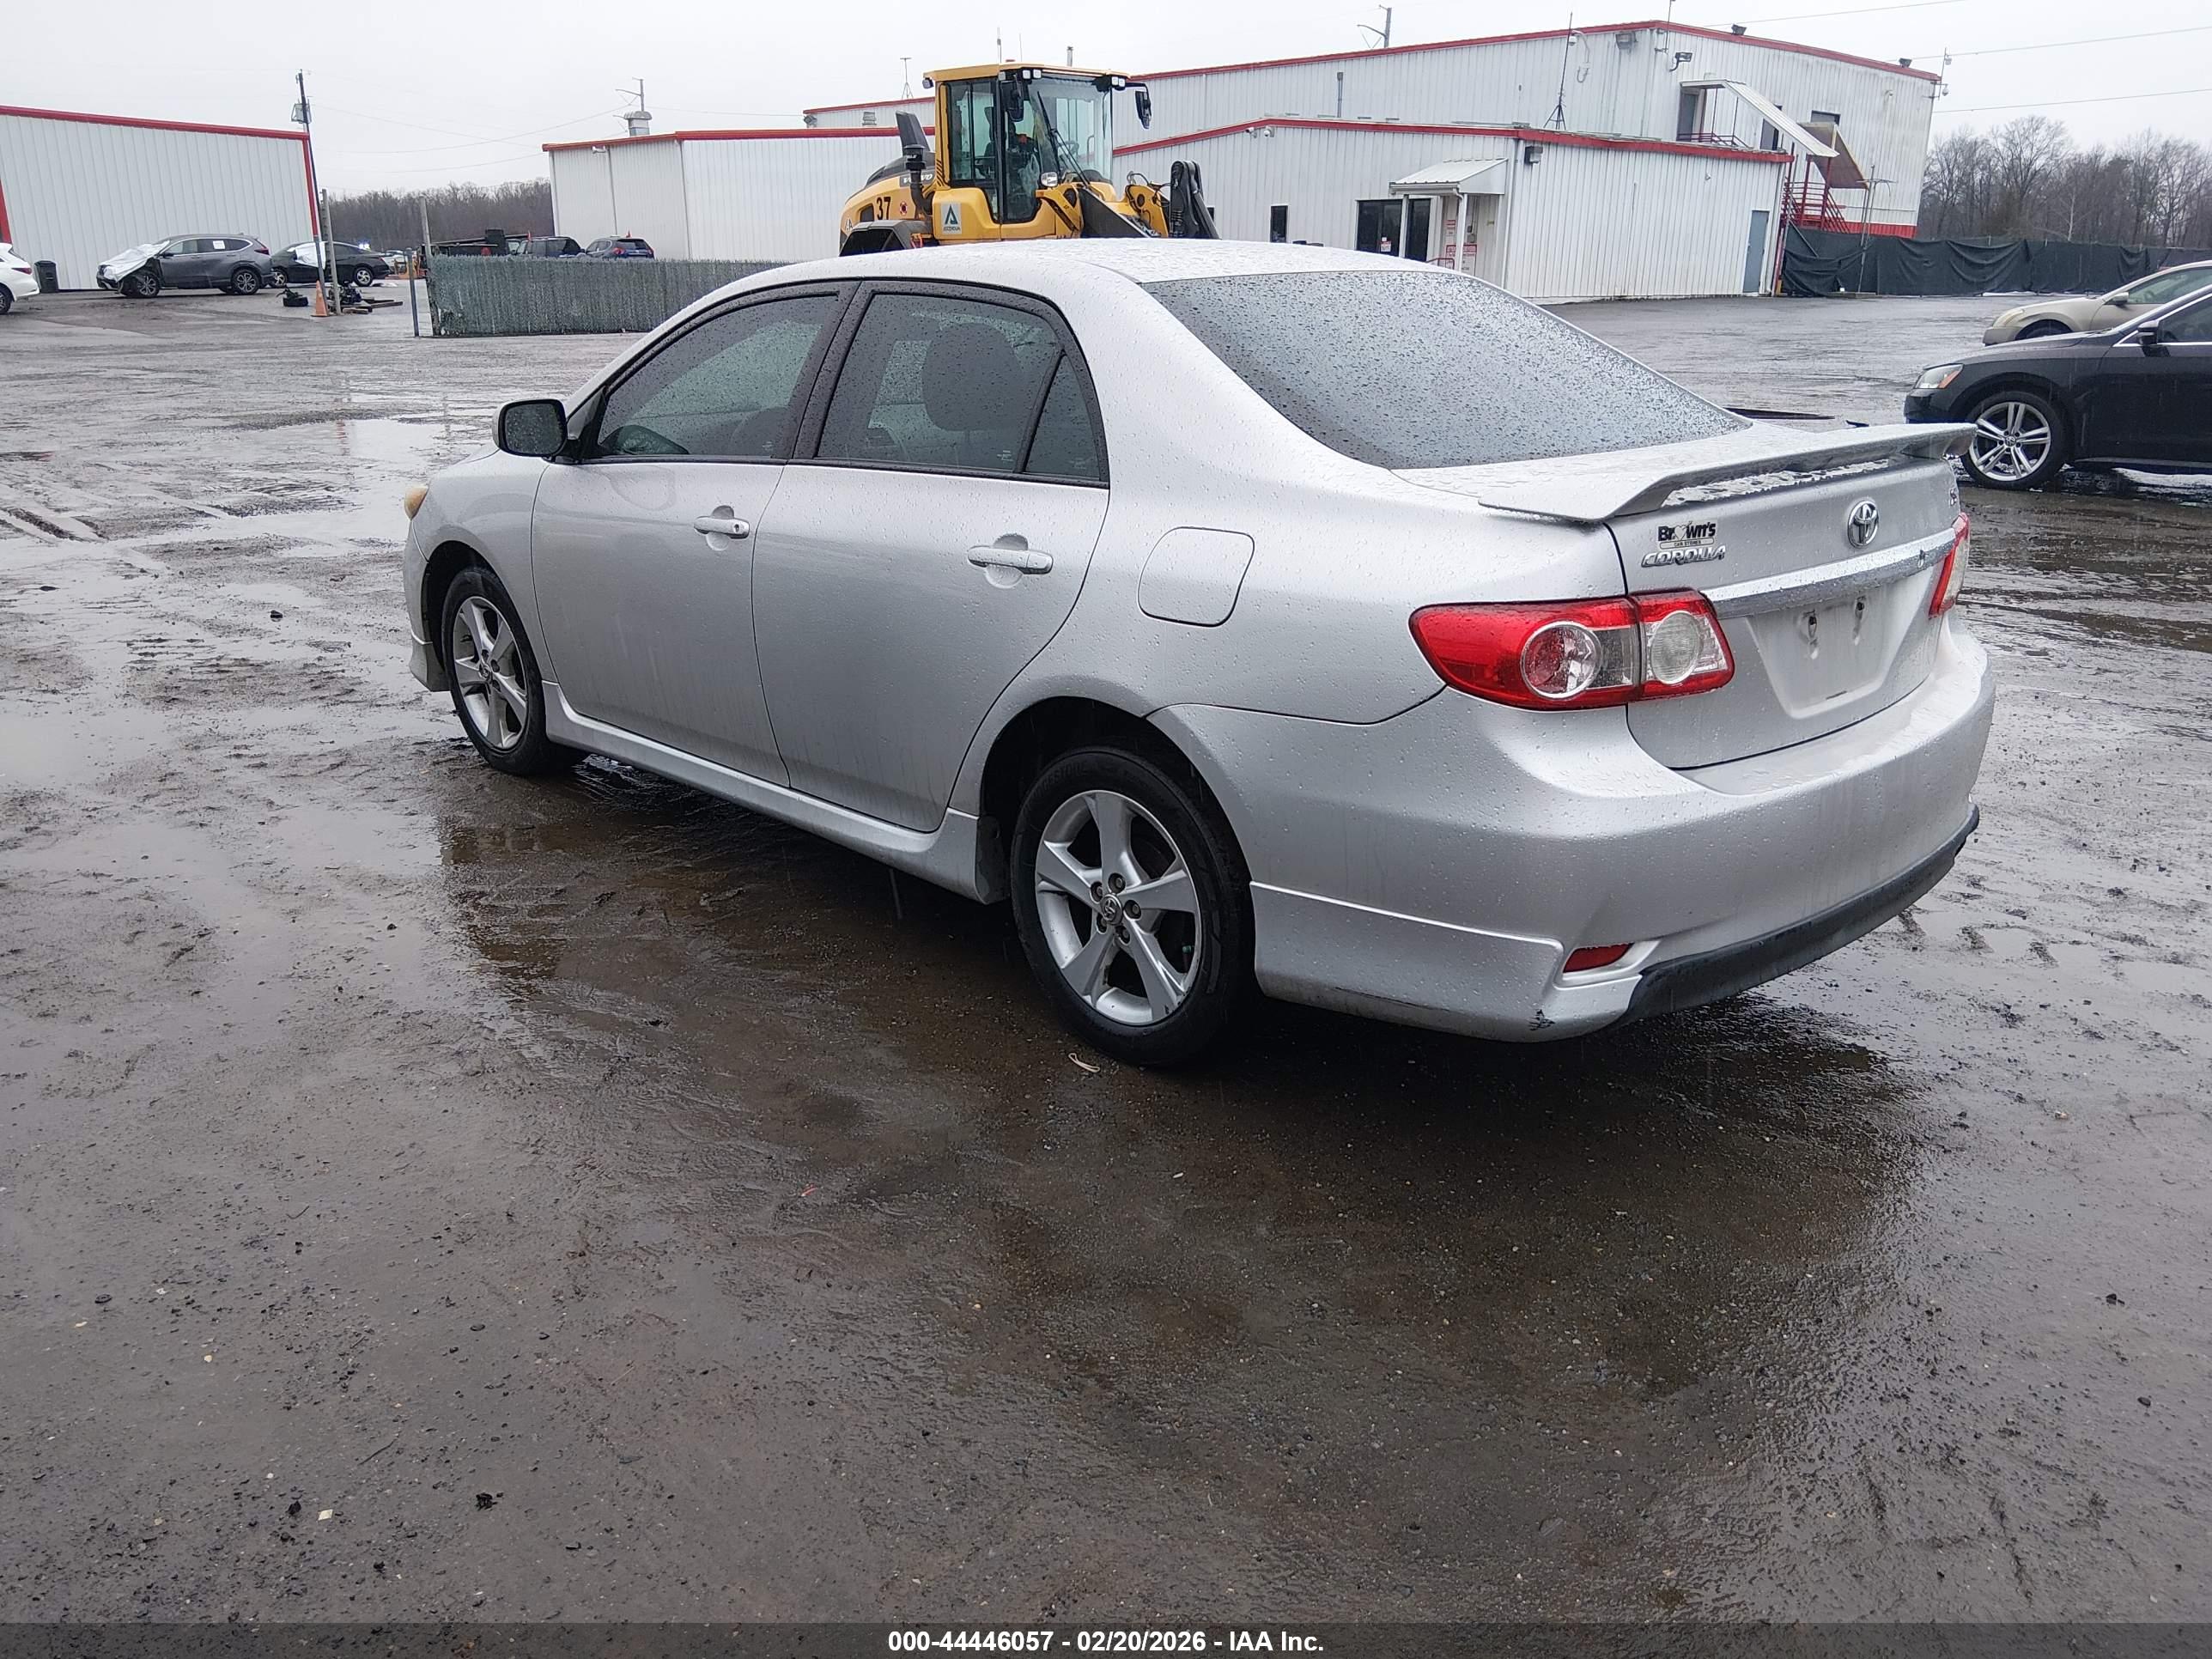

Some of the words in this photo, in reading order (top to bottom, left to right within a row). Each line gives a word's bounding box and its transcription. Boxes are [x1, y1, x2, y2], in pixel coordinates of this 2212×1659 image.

[903, 173, 933, 183] VVO
[877, 197, 891, 220] 37
[1641, 545, 1726, 568] COROLLA
